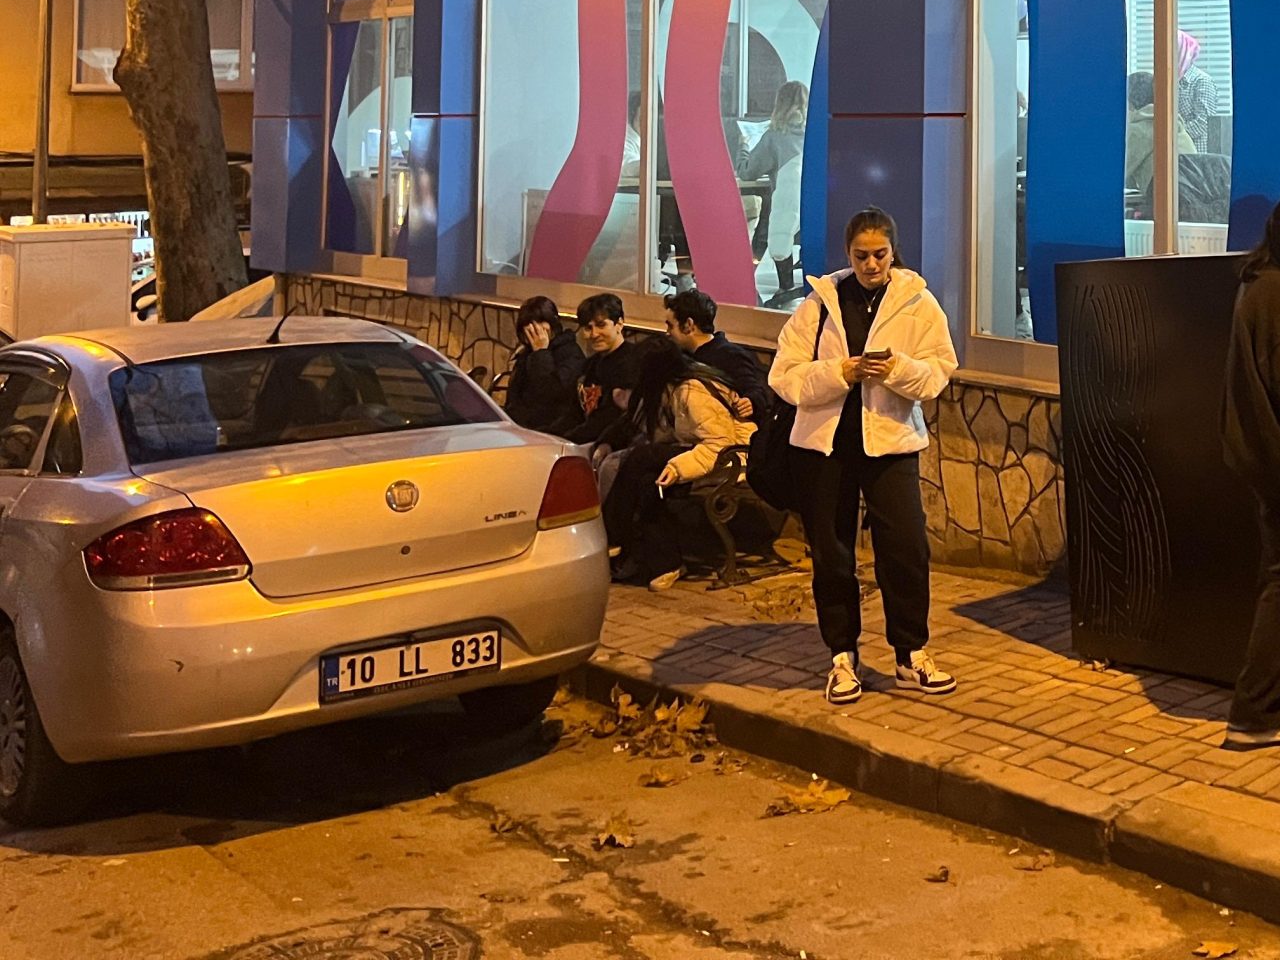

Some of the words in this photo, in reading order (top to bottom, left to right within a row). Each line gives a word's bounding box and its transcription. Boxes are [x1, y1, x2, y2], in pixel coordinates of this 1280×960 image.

[485, 510, 527, 523] LINEA
[327, 677, 338, 687] TR
[347, 655, 375, 686] 10
[399, 647, 428, 677] LL
[451, 635, 495, 667] 833
